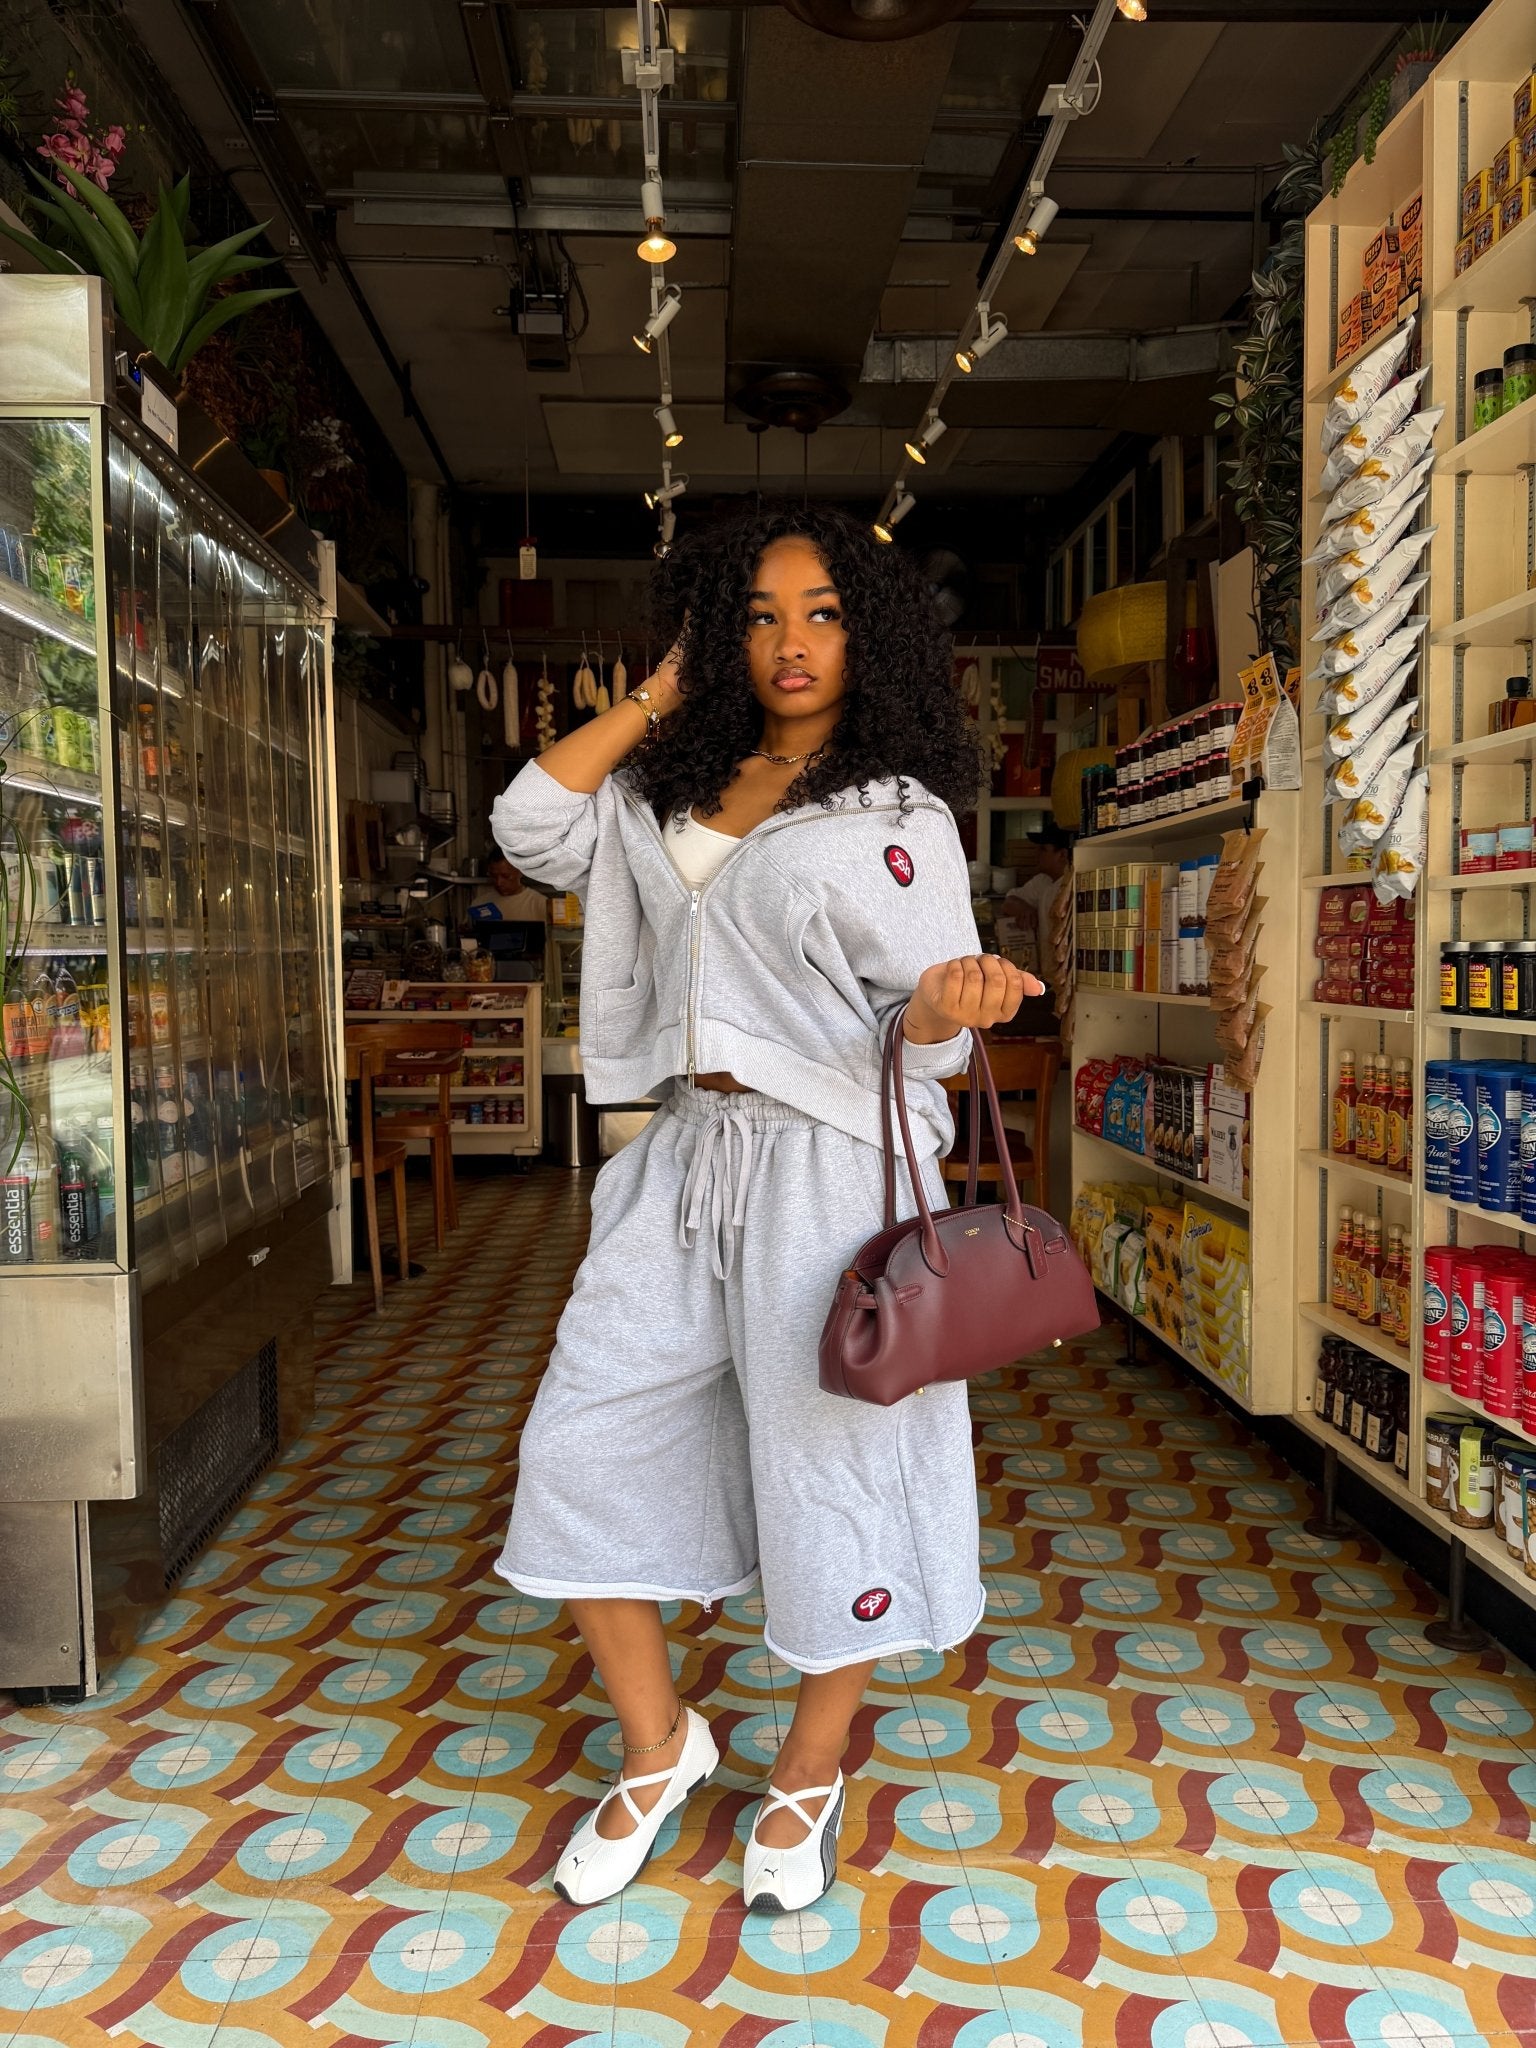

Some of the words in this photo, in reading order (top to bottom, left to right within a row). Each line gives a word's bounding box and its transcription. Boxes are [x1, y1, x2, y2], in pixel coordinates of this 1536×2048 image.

[1403, 200, 1420, 226] RIO
[1366, 239, 1381, 263] RIO
[1374, 273, 1386, 292] RIO
[1373, 301, 1384, 316] RIO
[1426, 1144, 1448, 1158] Fine
[5, 1189, 22, 1255] essentia
[66, 1192, 81, 1243] essentia
